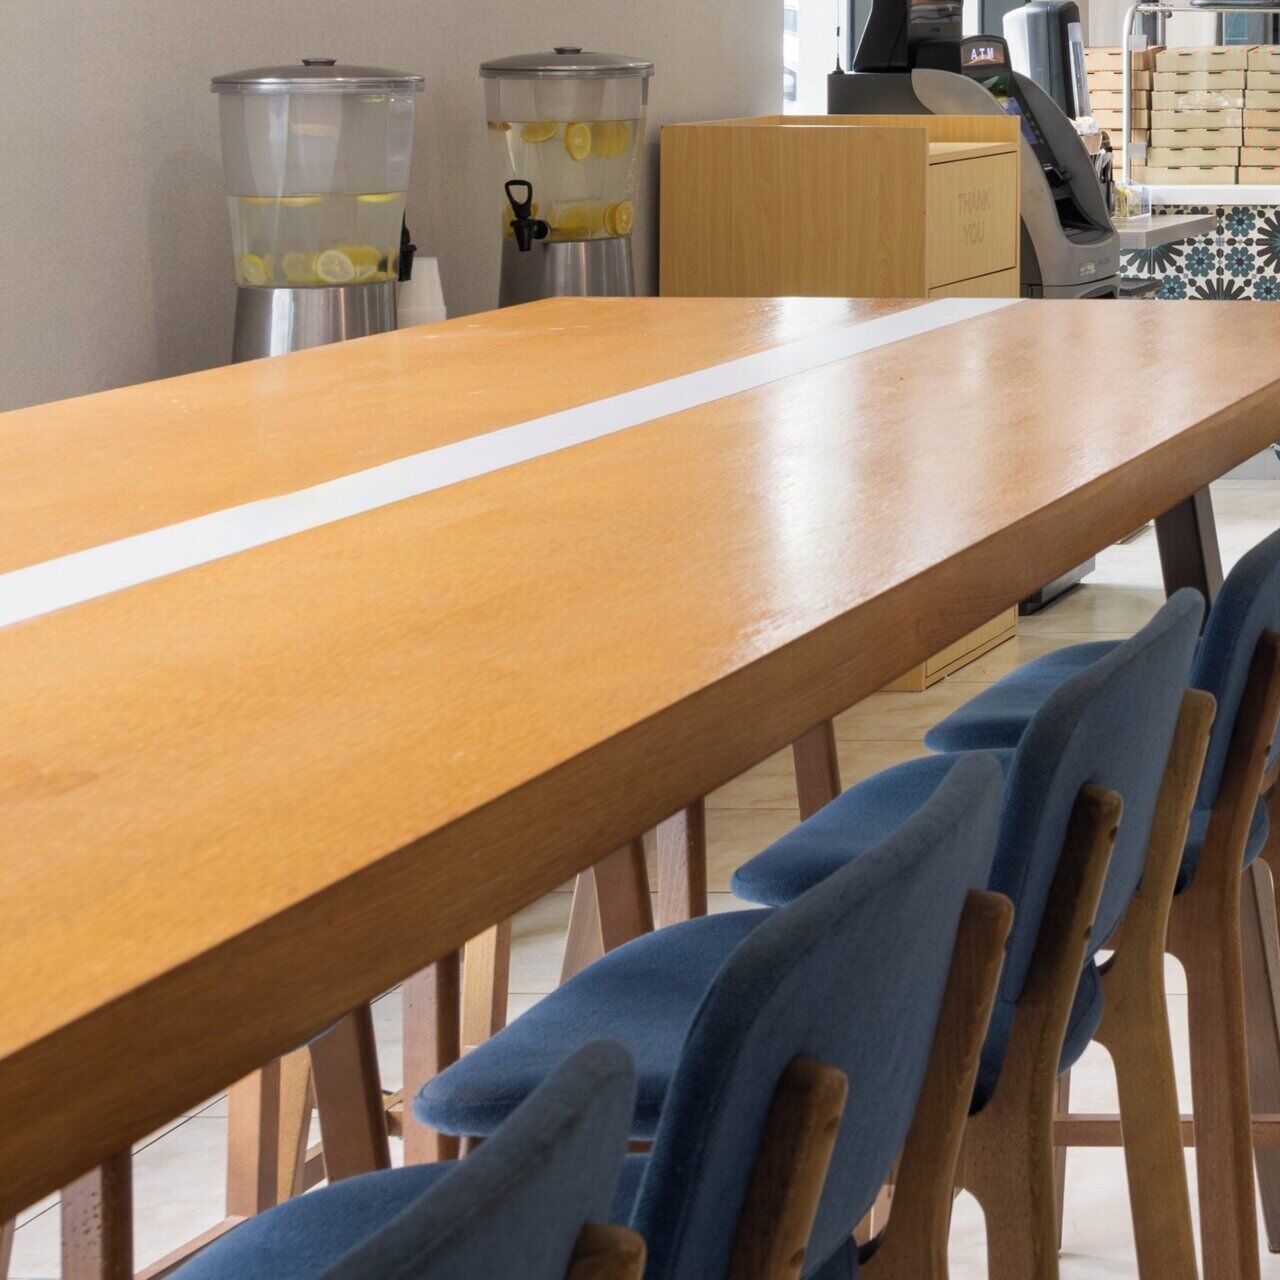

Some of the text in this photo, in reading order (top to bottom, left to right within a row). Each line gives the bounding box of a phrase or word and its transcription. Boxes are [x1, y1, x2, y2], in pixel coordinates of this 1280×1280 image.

[971, 47, 994, 60] ATM
[956, 187, 991, 215] THANK
[963, 221, 985, 246] YOU
